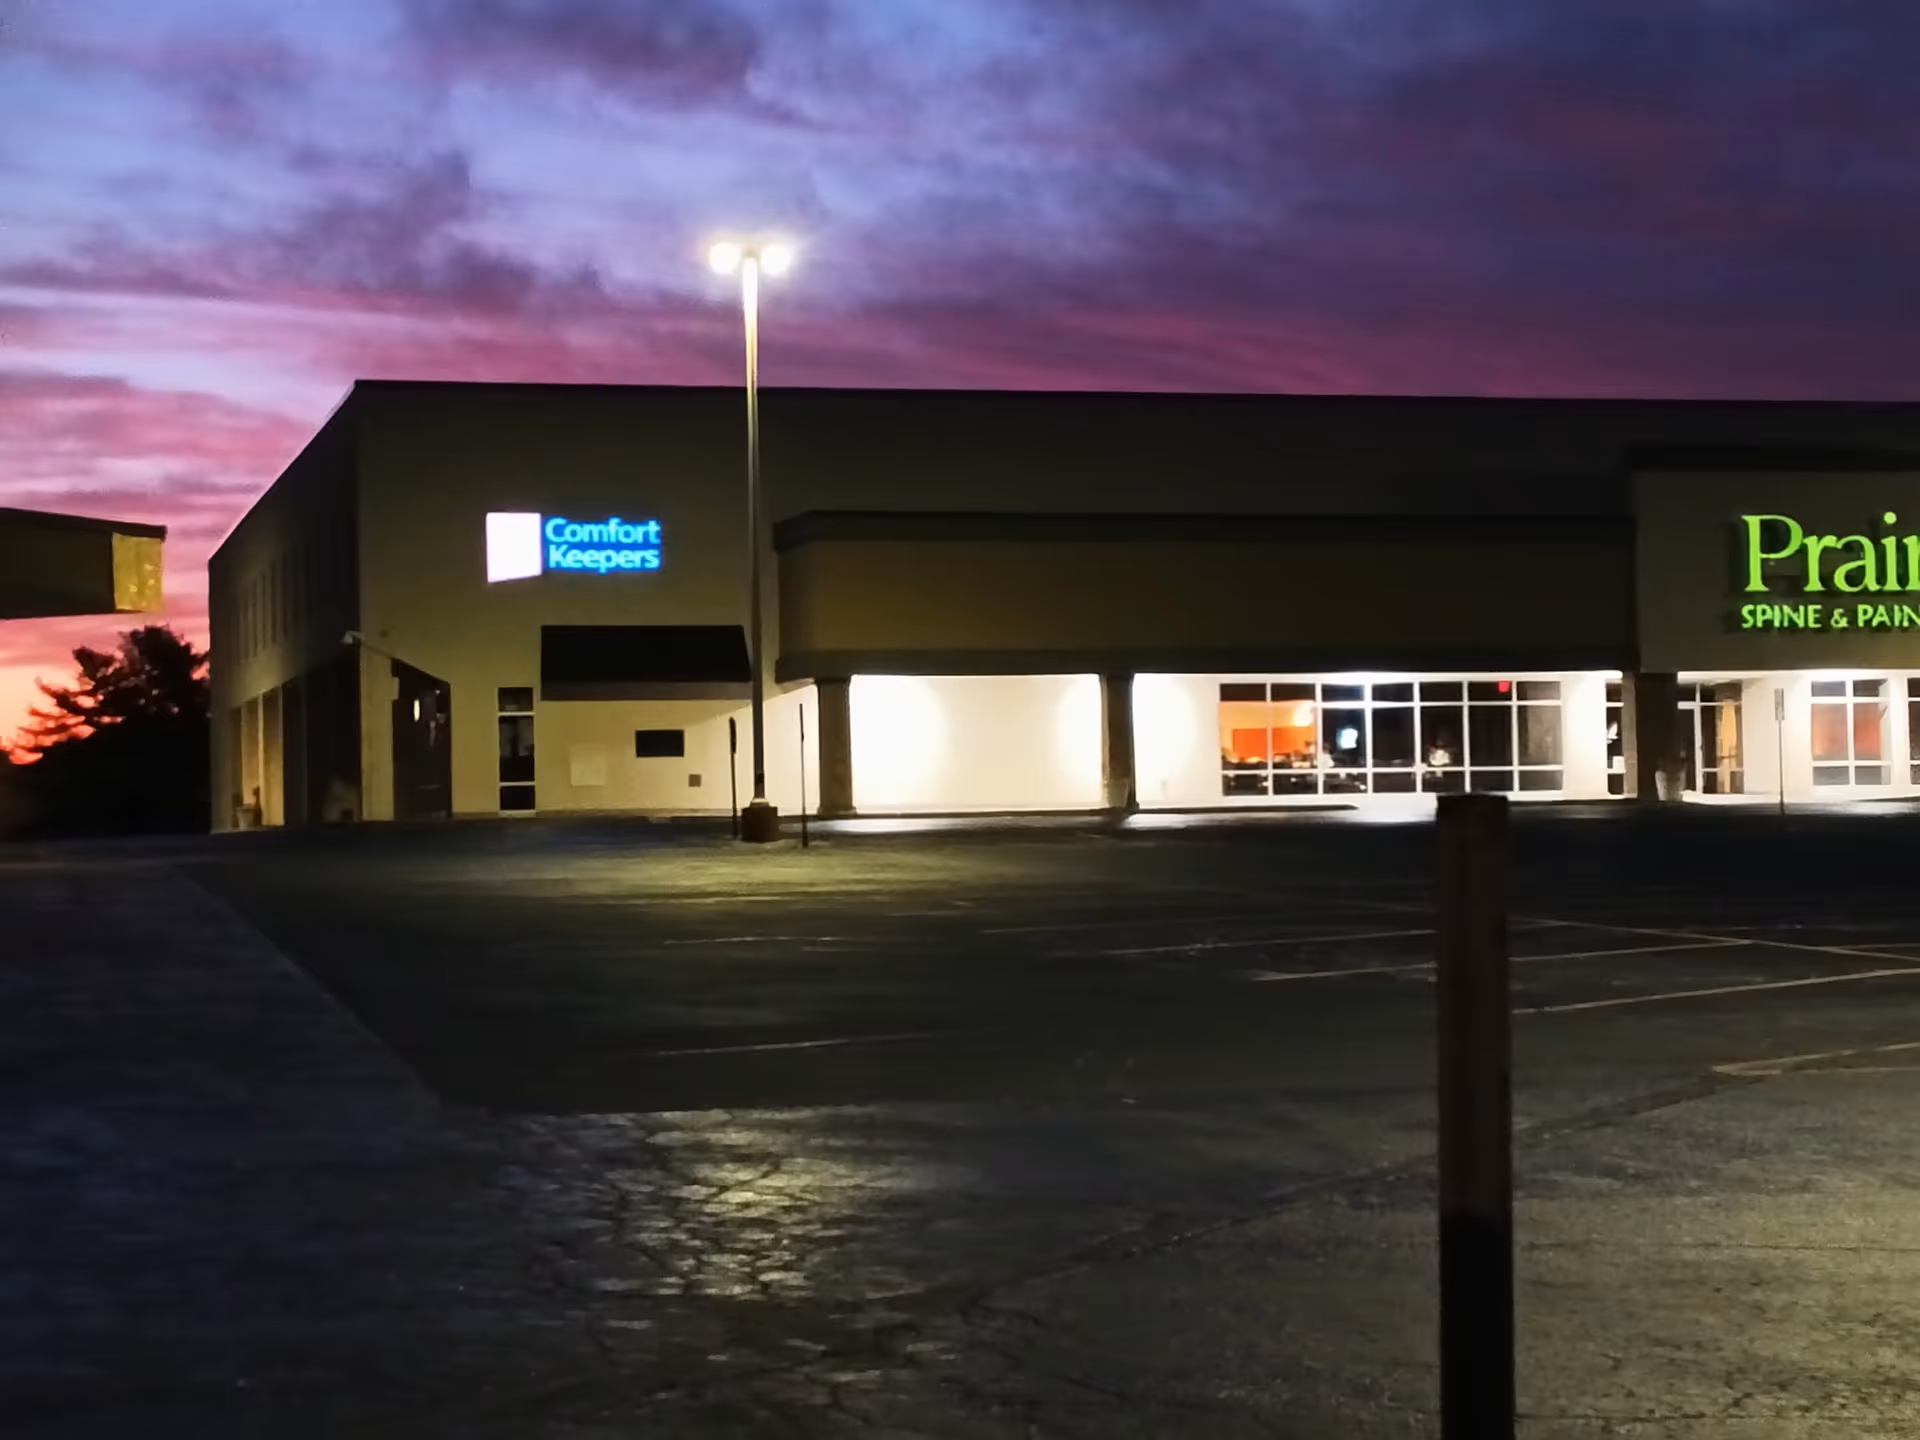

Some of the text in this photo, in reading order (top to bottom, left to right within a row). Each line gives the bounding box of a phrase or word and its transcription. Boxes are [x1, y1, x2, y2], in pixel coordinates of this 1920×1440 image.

[545, 517, 661, 544] Comfort
[549, 545, 660, 574] Keepers
[1741, 604, 1920, 628] SPINE & PAIN
